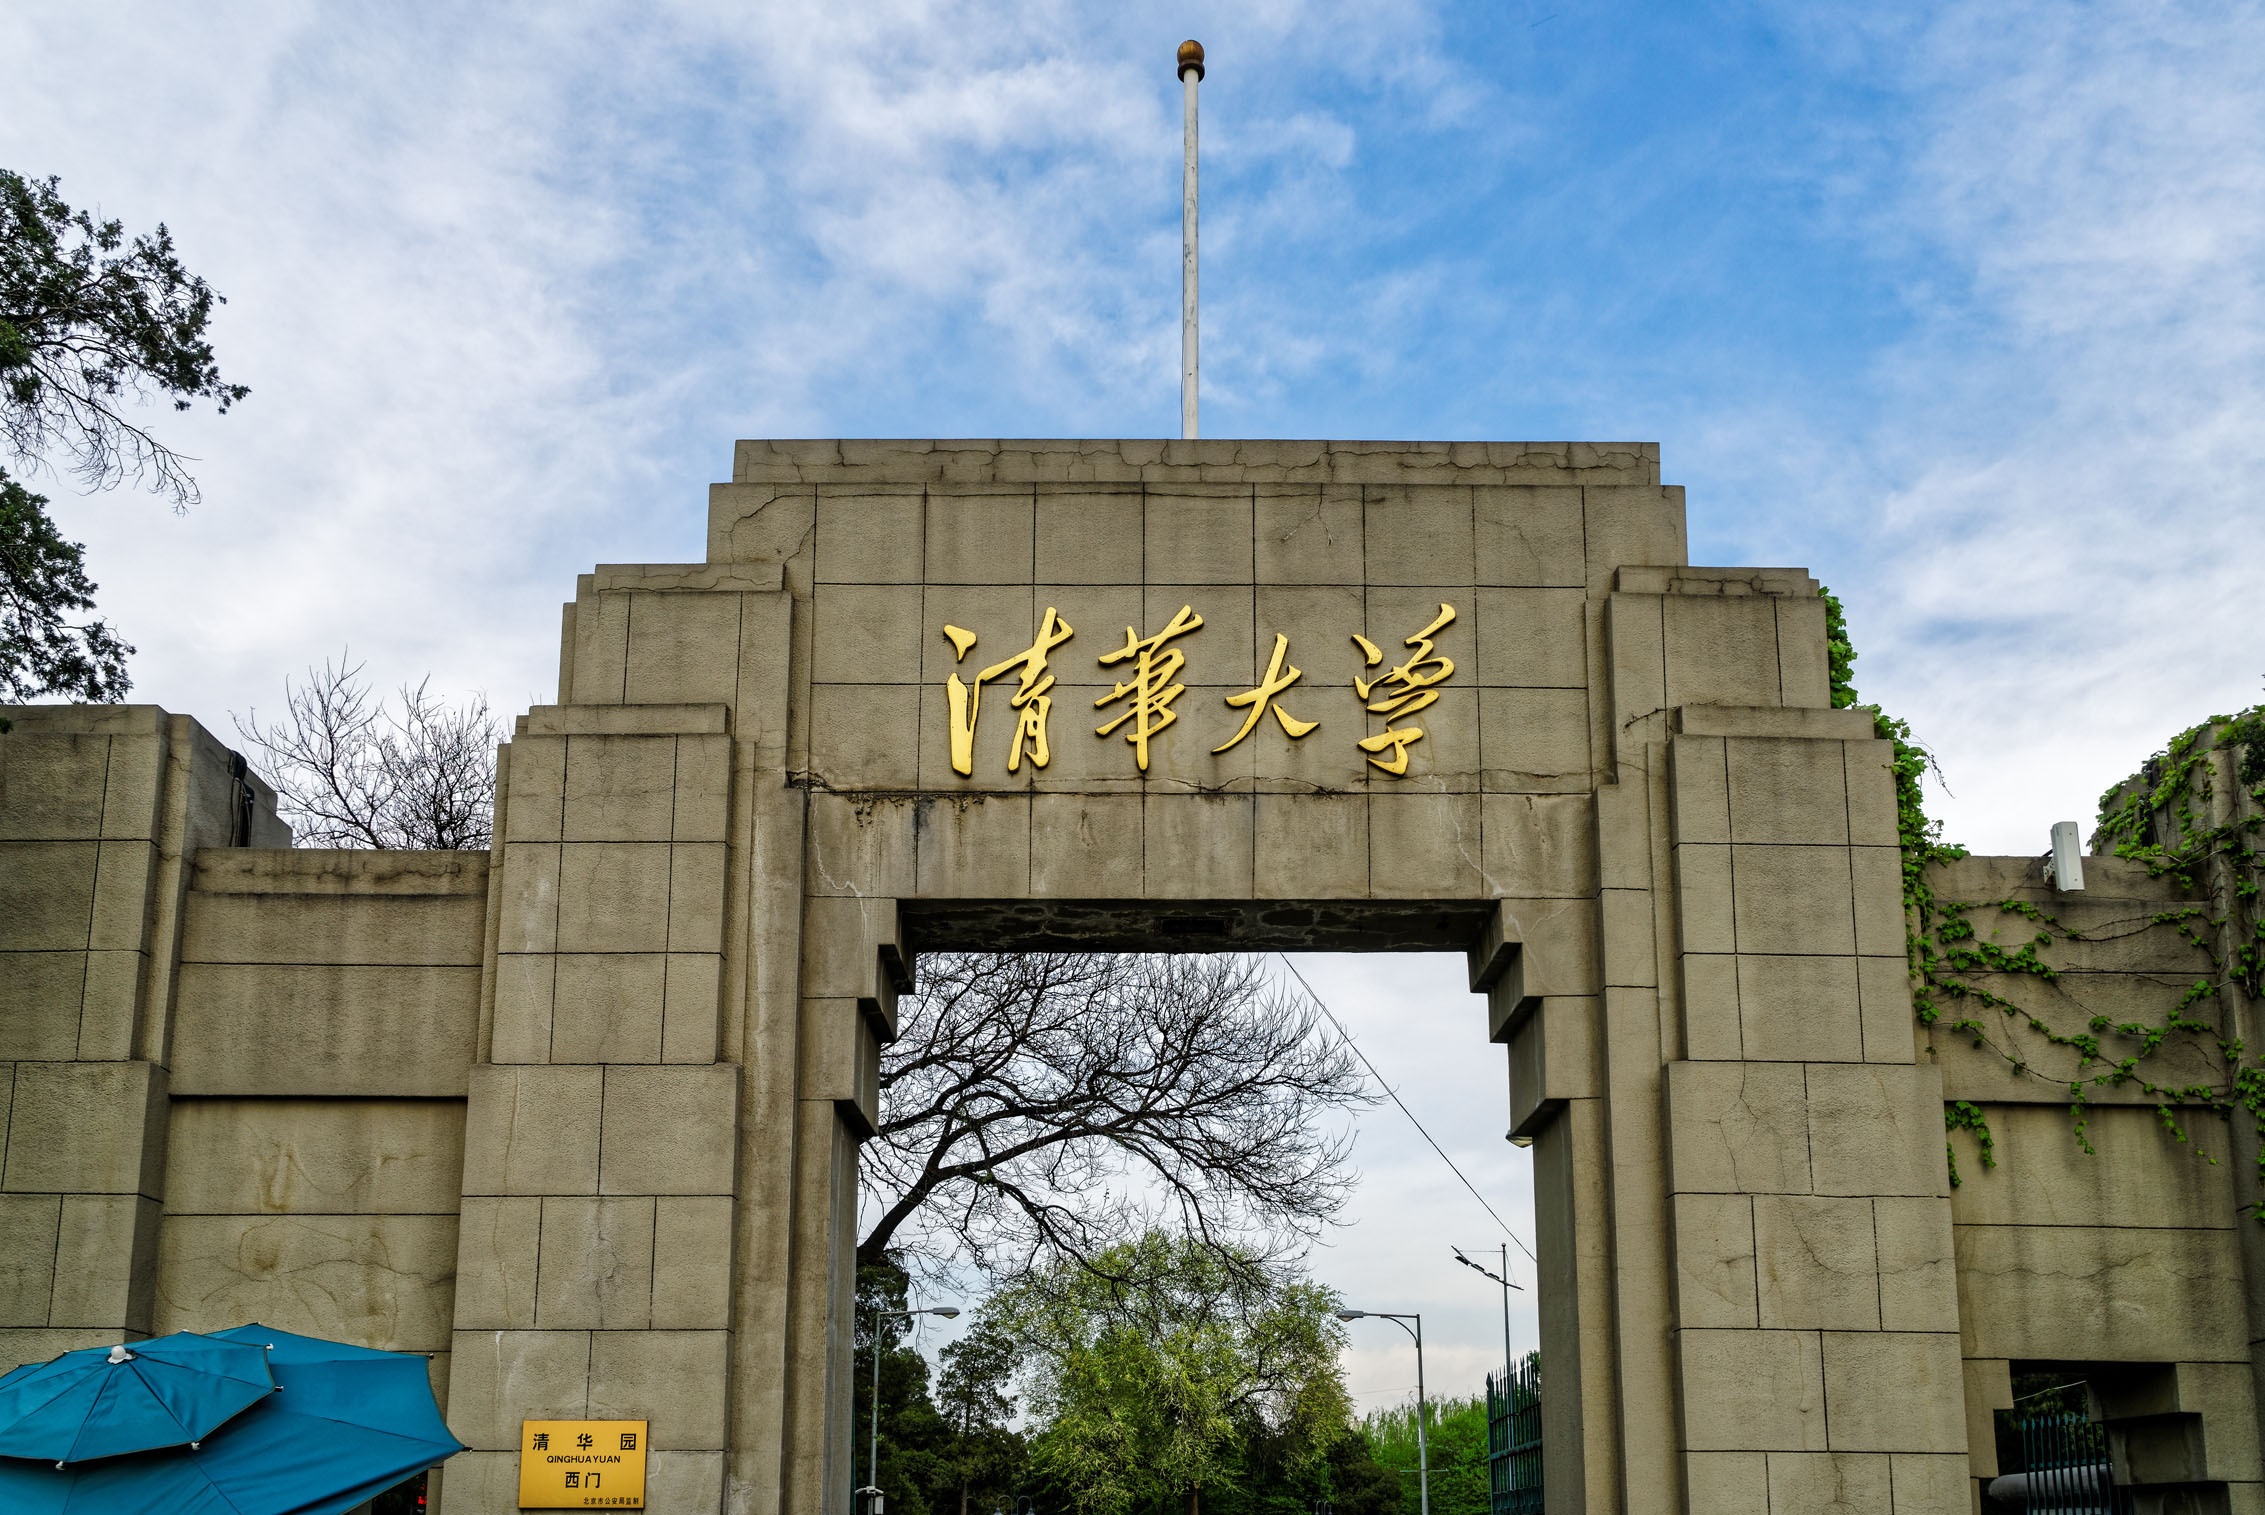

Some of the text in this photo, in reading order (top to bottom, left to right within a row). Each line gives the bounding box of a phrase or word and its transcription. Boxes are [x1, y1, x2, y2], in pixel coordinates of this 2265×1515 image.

[533, 1433, 637, 1451] 清华园
[547, 1455, 621, 1464] QINGHUAYUAN
[565, 1471, 601, 1489] 西门
[583, 1497, 639, 1505] 北京市公安局监制
